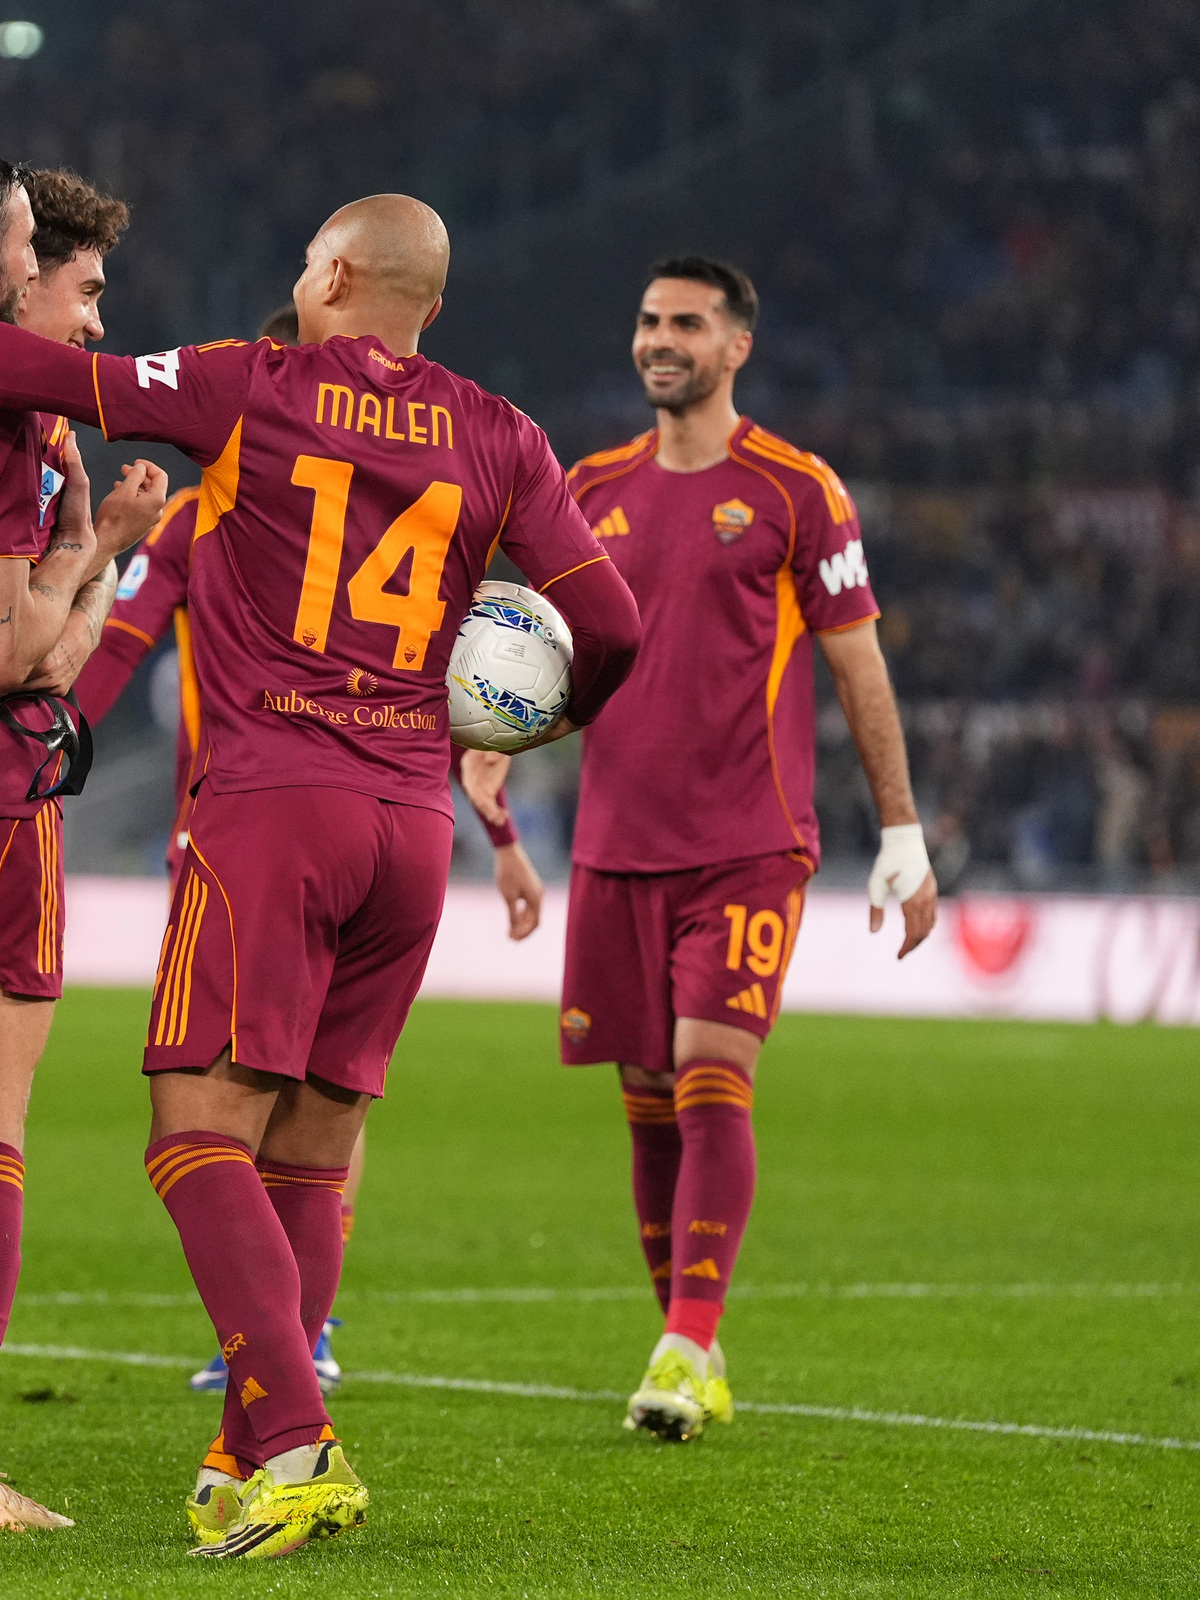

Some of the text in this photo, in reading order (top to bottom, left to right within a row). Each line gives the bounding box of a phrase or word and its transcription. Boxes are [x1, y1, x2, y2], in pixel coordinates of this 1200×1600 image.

[315, 382, 454, 449] MALEN
[290, 454, 463, 671] 14
[262, 689, 437, 730] Auberge Collection
[723, 903, 784, 978] 19
